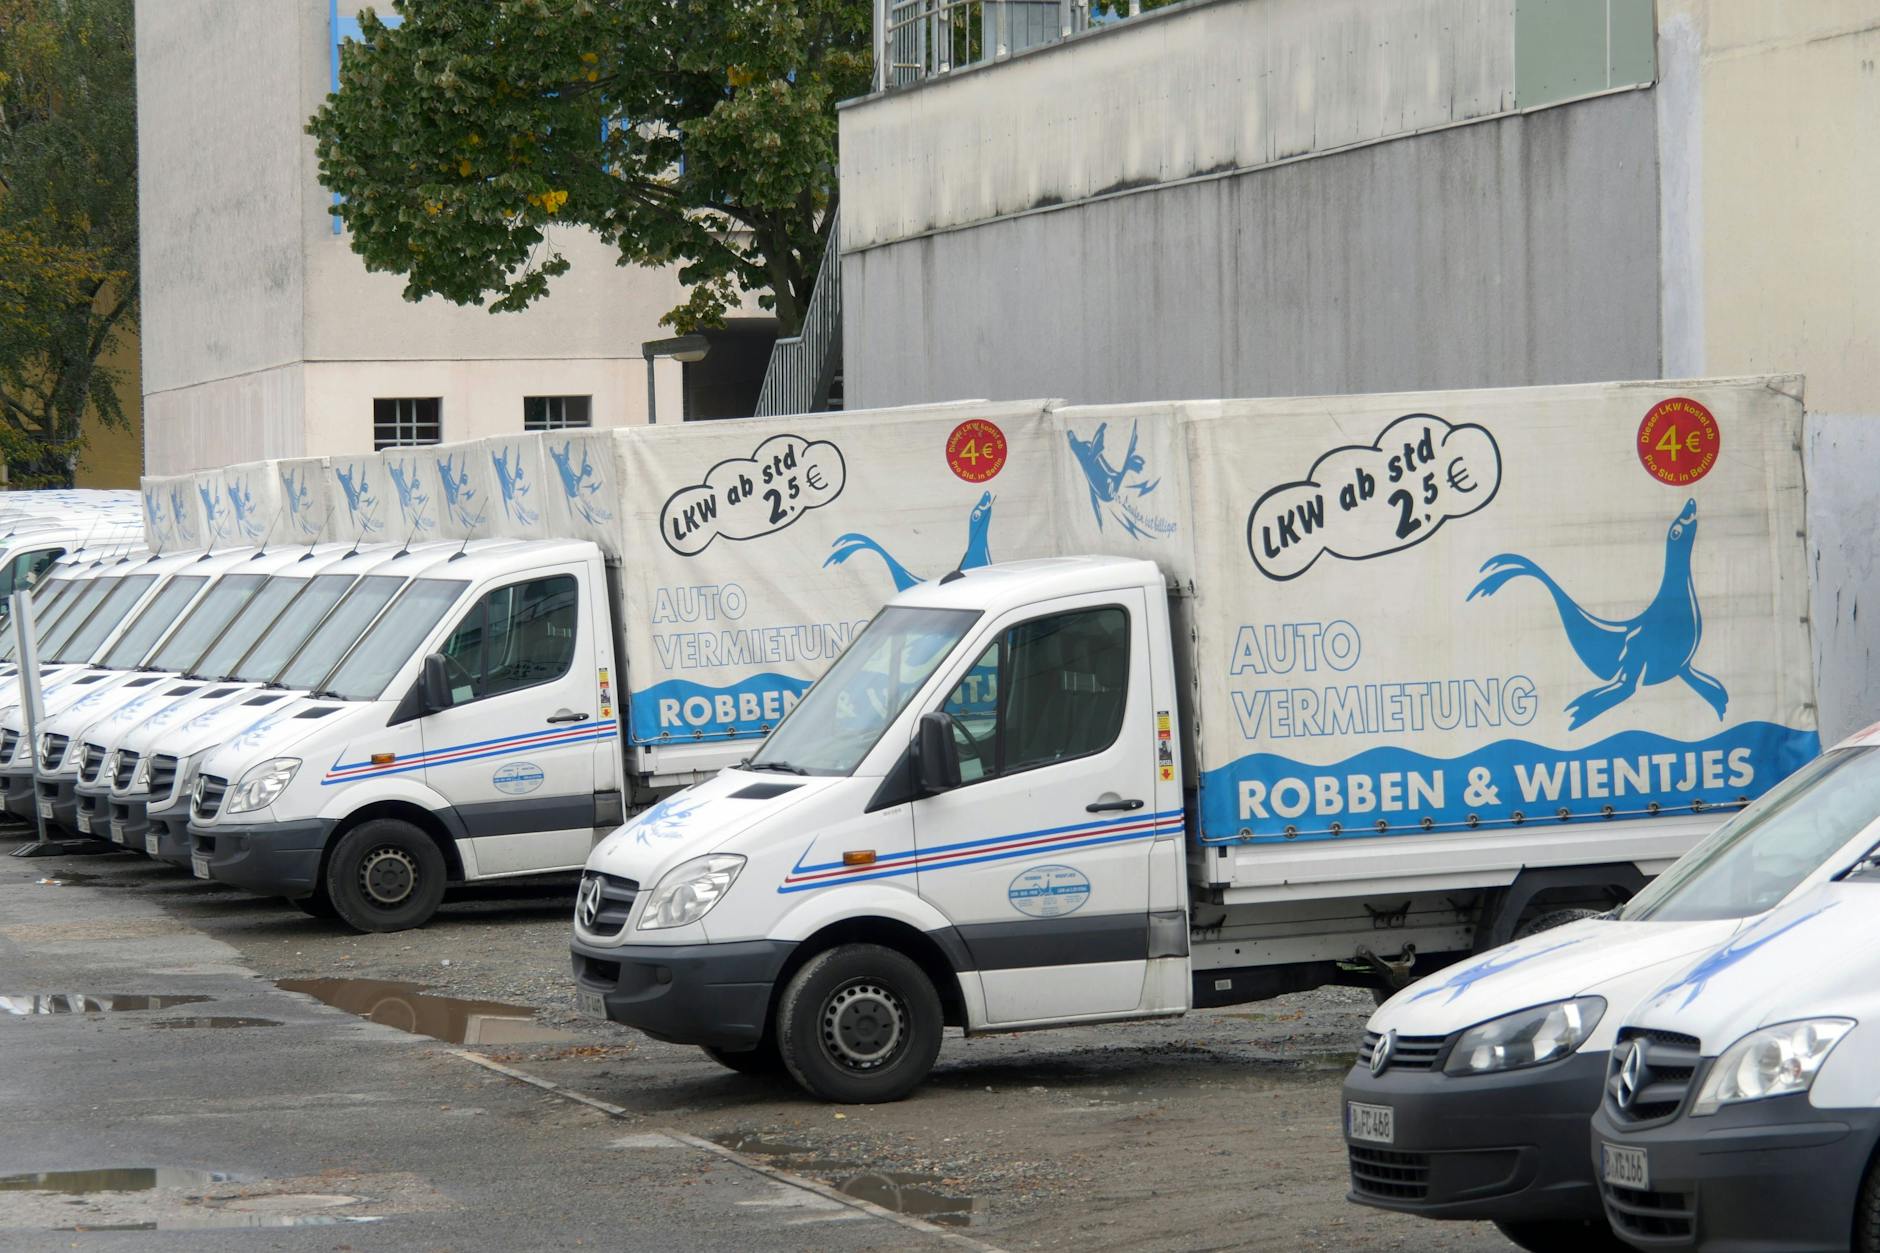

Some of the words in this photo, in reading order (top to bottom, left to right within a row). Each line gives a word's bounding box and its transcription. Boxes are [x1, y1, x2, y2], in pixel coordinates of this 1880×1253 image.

[1641, 412, 1659, 443] Dieser
[1659, 402, 1682, 415] LKW
[1684, 403, 1710, 426] kostet
[1706, 428, 1714, 440] ab
[673, 494, 716, 540] LKW
[727, 474, 753, 505] ab
[762, 444, 797, 484] std
[952, 460, 961, 473] Pro
[978, 472, 985, 480] in
[986, 458, 1002, 477] Berlin
[1262, 494, 1324, 559] LKW
[1339, 468, 1375, 511] ab
[1387, 427, 1435, 483] std
[1644, 454, 1657, 471] Pro
[1658, 468, 1676, 481] Std.
[1680, 472, 1689, 481] in
[1690, 452, 1713, 477] Berlin
[652, 583, 747, 624] AUTO
[1230, 620, 1361, 675] AUTO
[1231, 675, 1537, 740] VERMIETUNG
[1238, 769, 1445, 820] ROBBEN
[1463, 766, 1501, 807] &
[1513, 747, 1755, 803] WIENTJES
